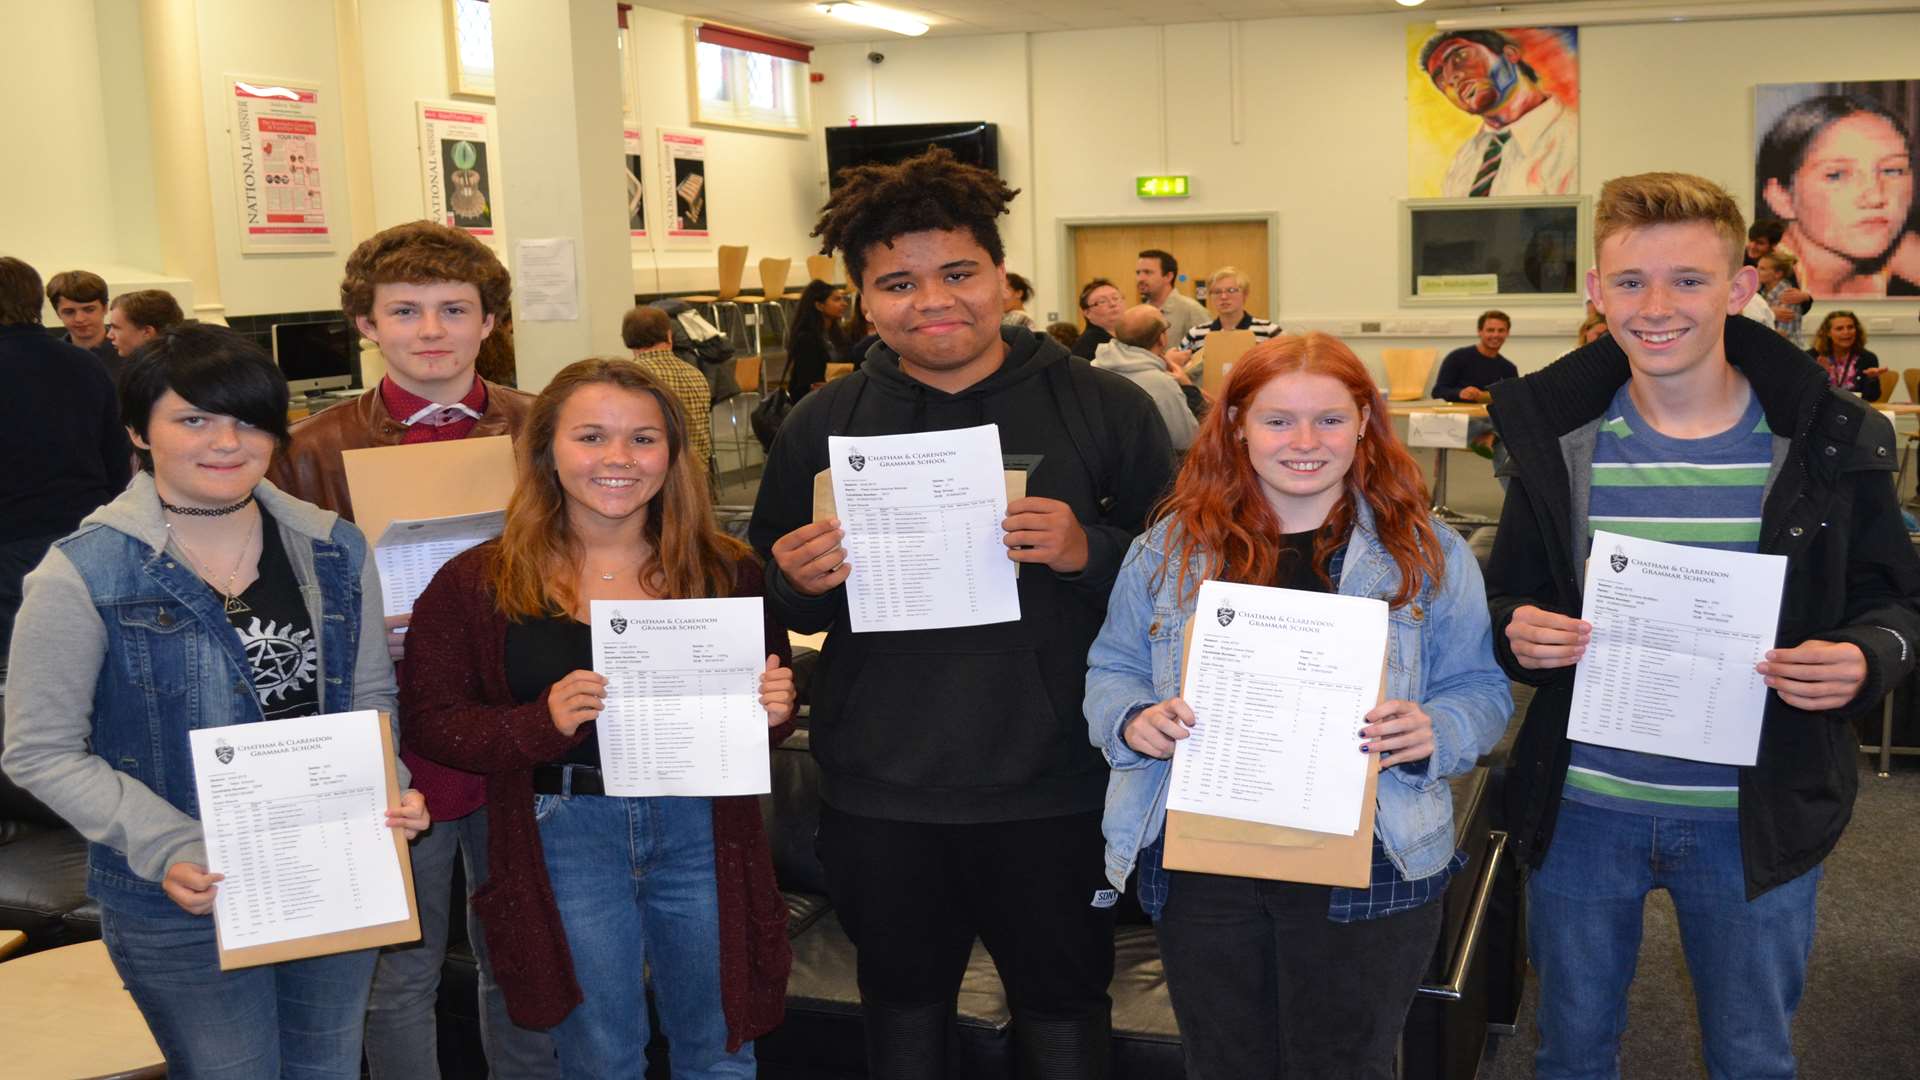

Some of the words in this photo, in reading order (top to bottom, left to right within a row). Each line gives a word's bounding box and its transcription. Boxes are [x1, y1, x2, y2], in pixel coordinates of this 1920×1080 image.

[241, 145, 260, 225] NATIONAL
[868, 454, 903, 462] CHATHAM
[912, 450, 957, 459] CLARENDON
[1631, 558, 1669, 571] CHATHAM
[1679, 565, 1729, 578] CLARENDON
[1642, 568, 1681, 580] GRAMMAR
[1683, 574, 1716, 584] SCHOOL
[1238, 611, 1277, 621] CHATHAM
[1286, 616, 1335, 628] CLARENDON
[1248, 620, 1288, 630] GRAMMAR
[1289, 624, 1321, 633] SCHOOL
[237, 742, 277, 752] CHATHAM
[286, 735, 333, 745] CLARENDON
[250, 747, 290, 757] GRAMMAR
[292, 743, 323, 752] SCHOOL
